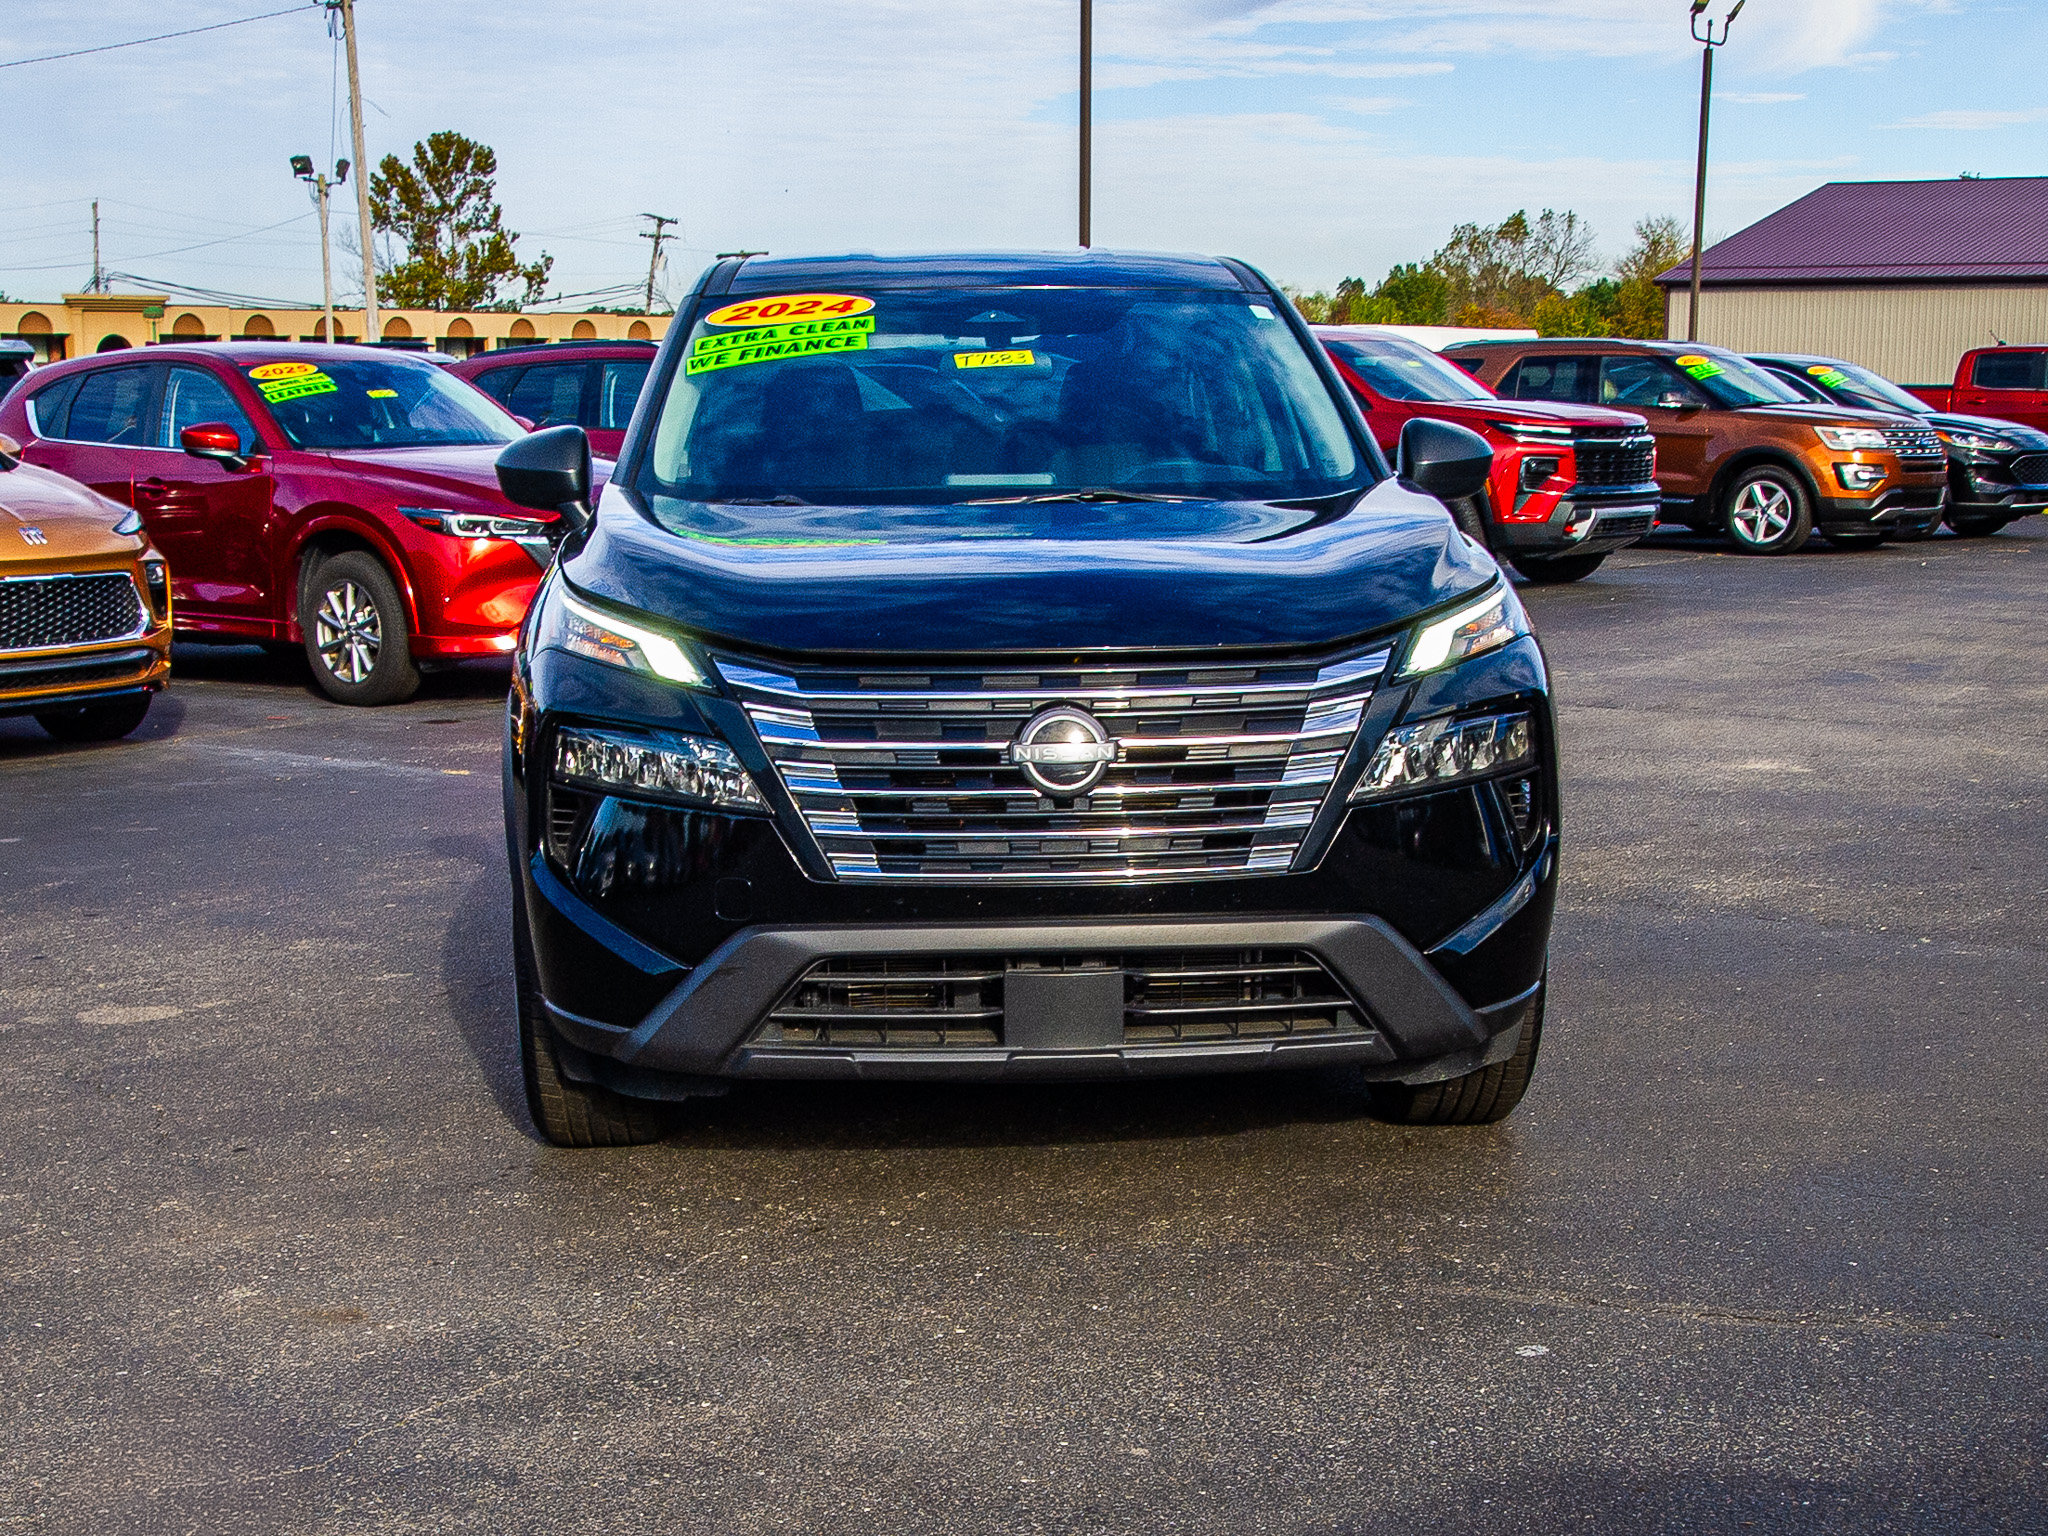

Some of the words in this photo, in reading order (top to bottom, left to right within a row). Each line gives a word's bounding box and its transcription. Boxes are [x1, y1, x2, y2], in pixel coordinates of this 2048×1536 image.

[721, 299, 858, 323] 2024
[698, 329, 776, 351] EXTRA
[789, 319, 870, 336] CLEAN
[690, 352, 733, 371] WE
[738, 335, 862, 361] FINANCE
[259, 364, 309, 378] 2025
[269, 383, 332, 400] LEATHER
[1015, 746, 1114, 761] NISAN
